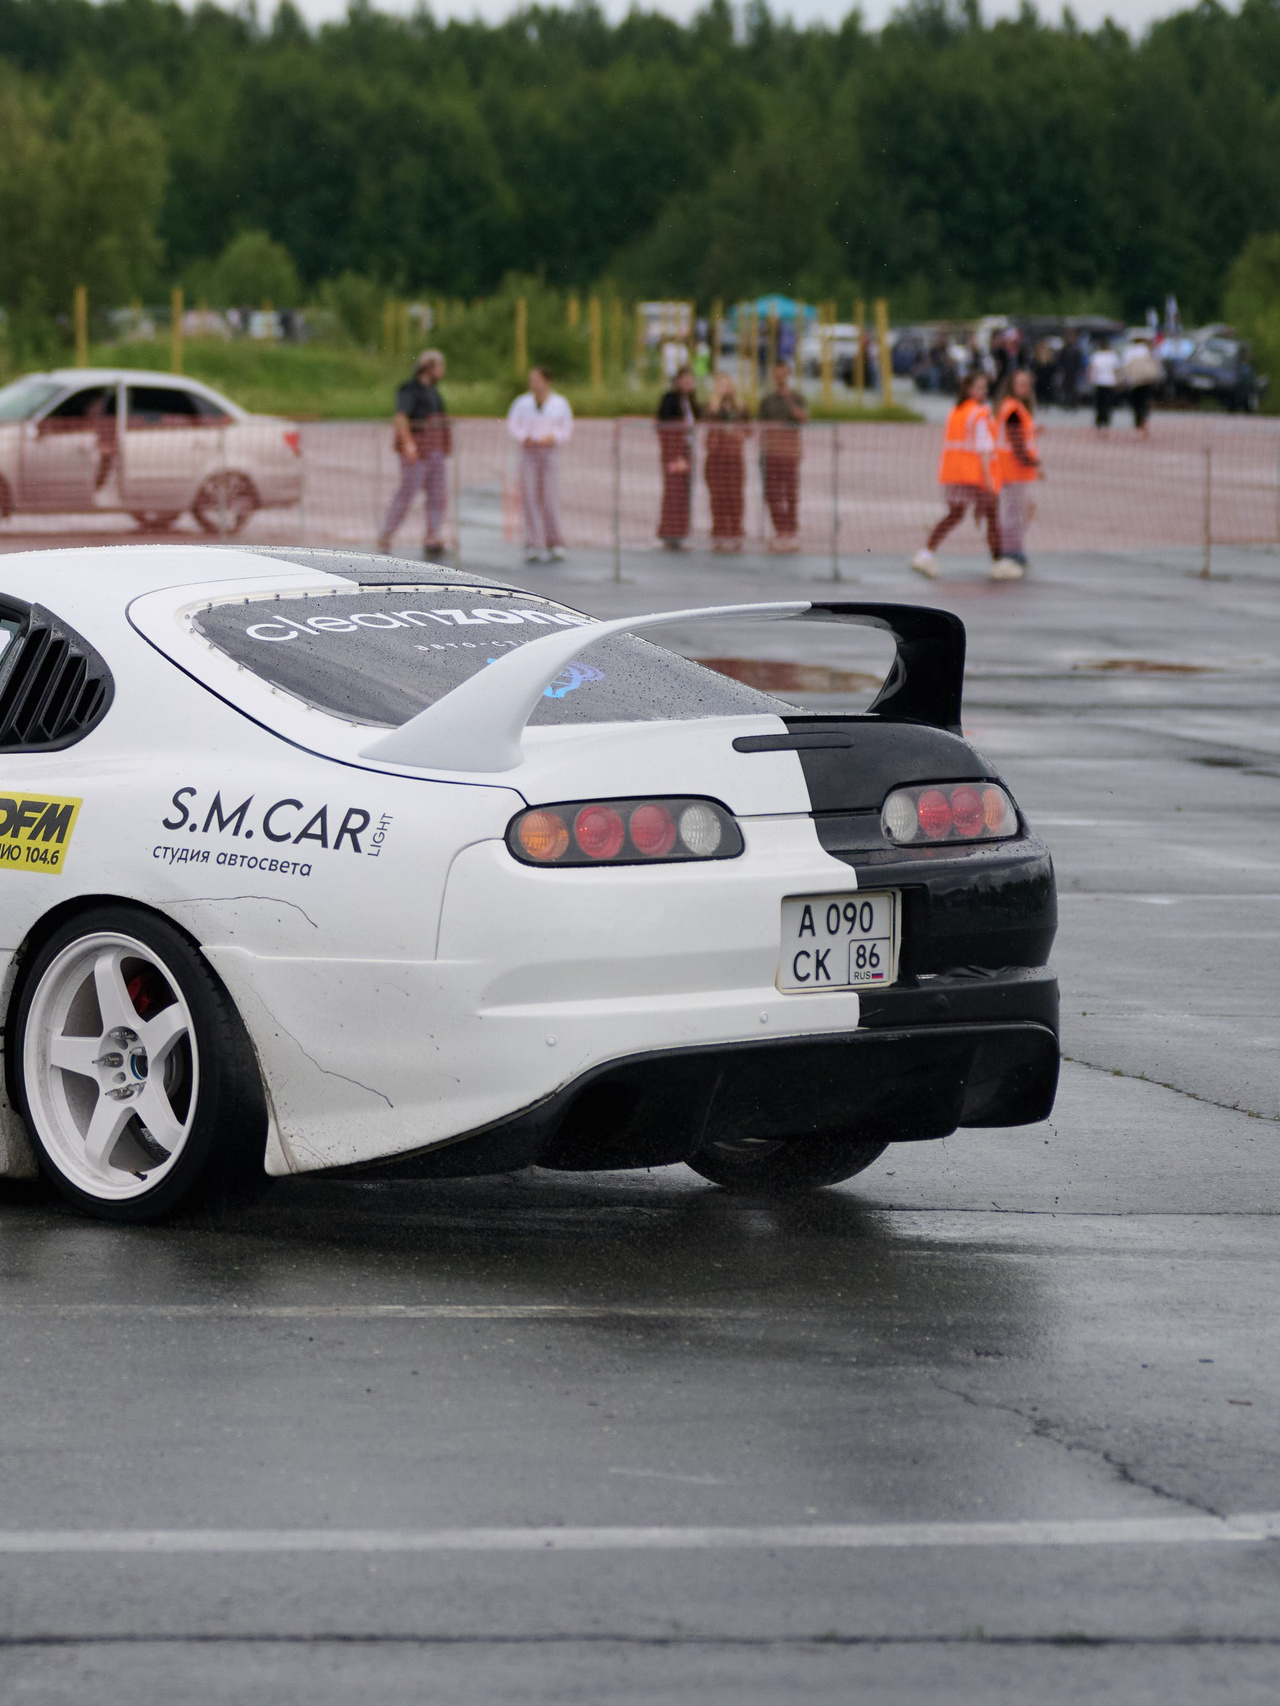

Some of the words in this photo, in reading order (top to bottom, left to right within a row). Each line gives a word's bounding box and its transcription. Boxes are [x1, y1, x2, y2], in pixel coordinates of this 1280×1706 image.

[162, 786, 371, 853] S.M.CAR
[367, 812, 394, 857] LIGHT
[25, 846, 60, 866] 104.6
[152, 845, 210, 865] студия
[215, 851, 313, 877] автосвета
[855, 943, 881, 969] 86
[854, 971, 871, 980] RUS
